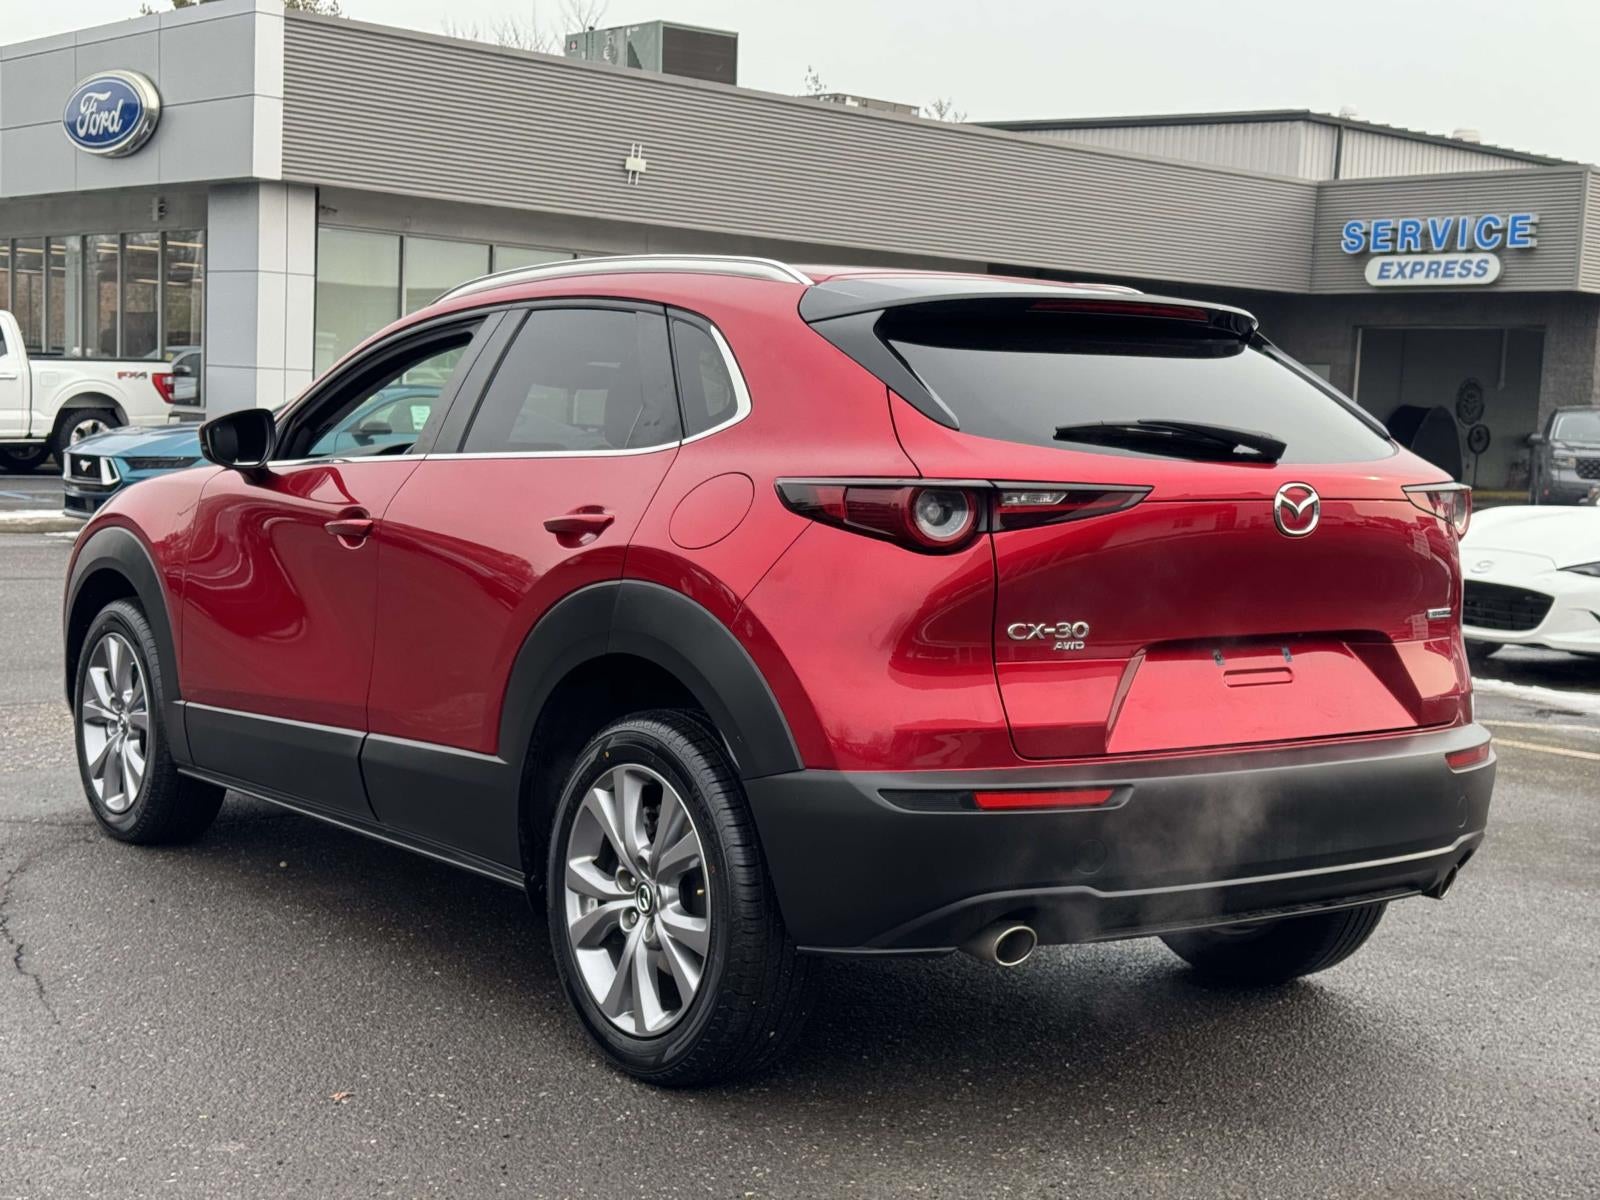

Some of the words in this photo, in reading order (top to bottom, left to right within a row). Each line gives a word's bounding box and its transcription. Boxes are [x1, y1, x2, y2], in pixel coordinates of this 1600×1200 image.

[76, 90, 124, 138] Ford
[1341, 214, 1535, 254] SERVICE
[1377, 258, 1490, 281] EXPRESS
[116, 370, 148, 380] FX4
[1007, 621, 1090, 640] CX-30
[1053, 641, 1086, 651] AWD
